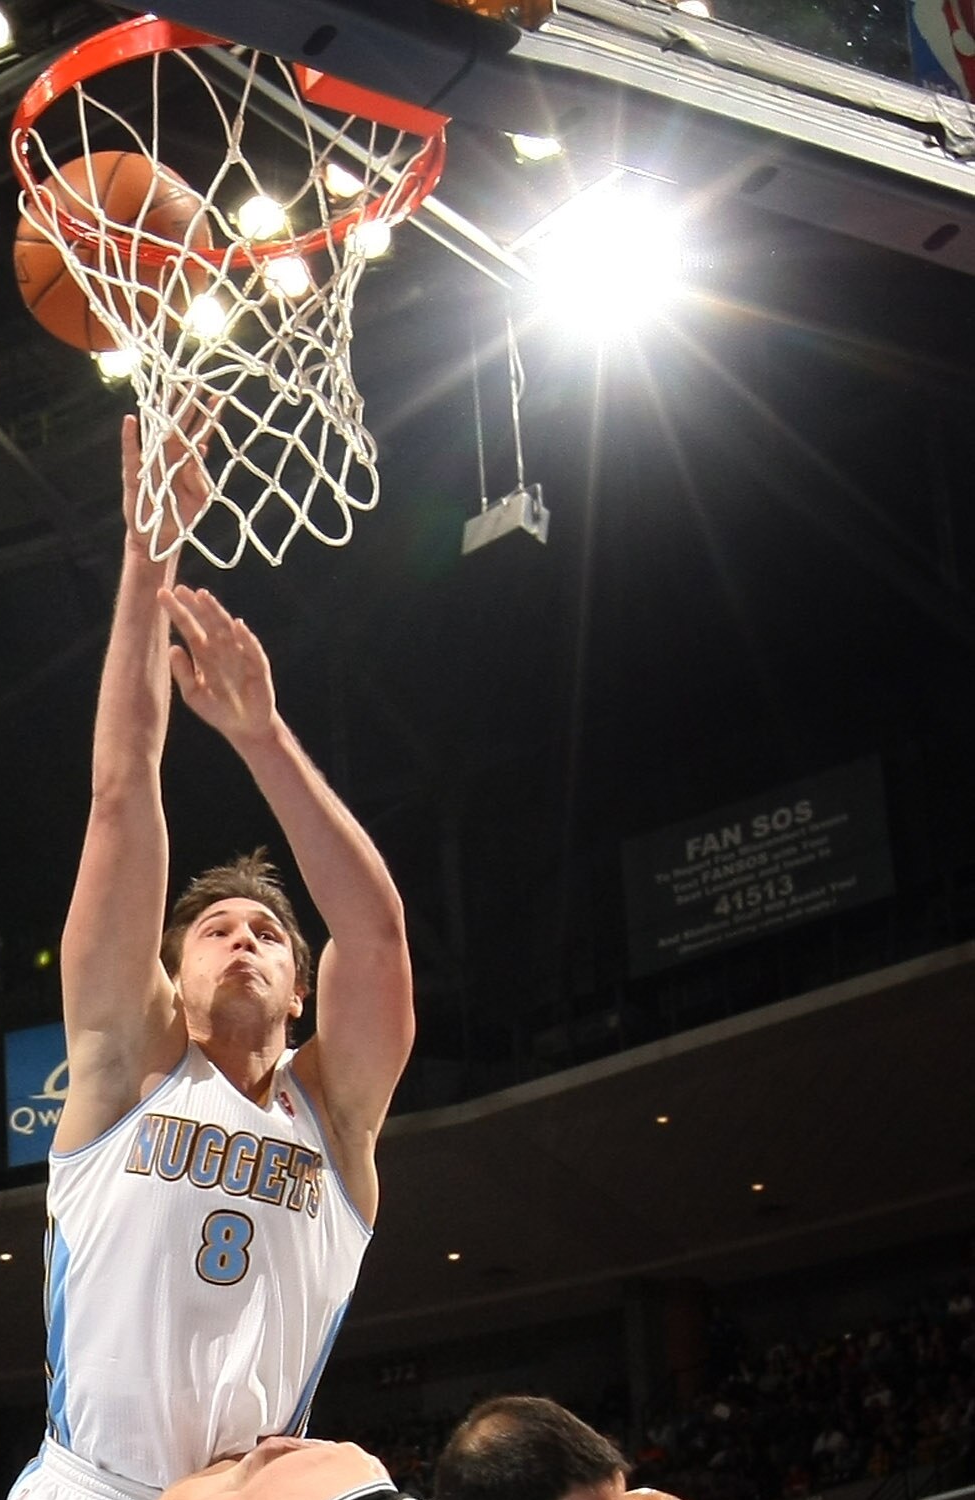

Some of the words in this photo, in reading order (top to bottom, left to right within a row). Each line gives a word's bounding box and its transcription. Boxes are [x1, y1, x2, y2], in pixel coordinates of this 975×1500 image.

[685, 824, 743, 862] FAN
[751, 800, 813, 838] SOS
[713, 873, 794, 917] 41513
[125, 1113, 324, 1219] NUGGETS
[196, 1209, 254, 1286] 8
